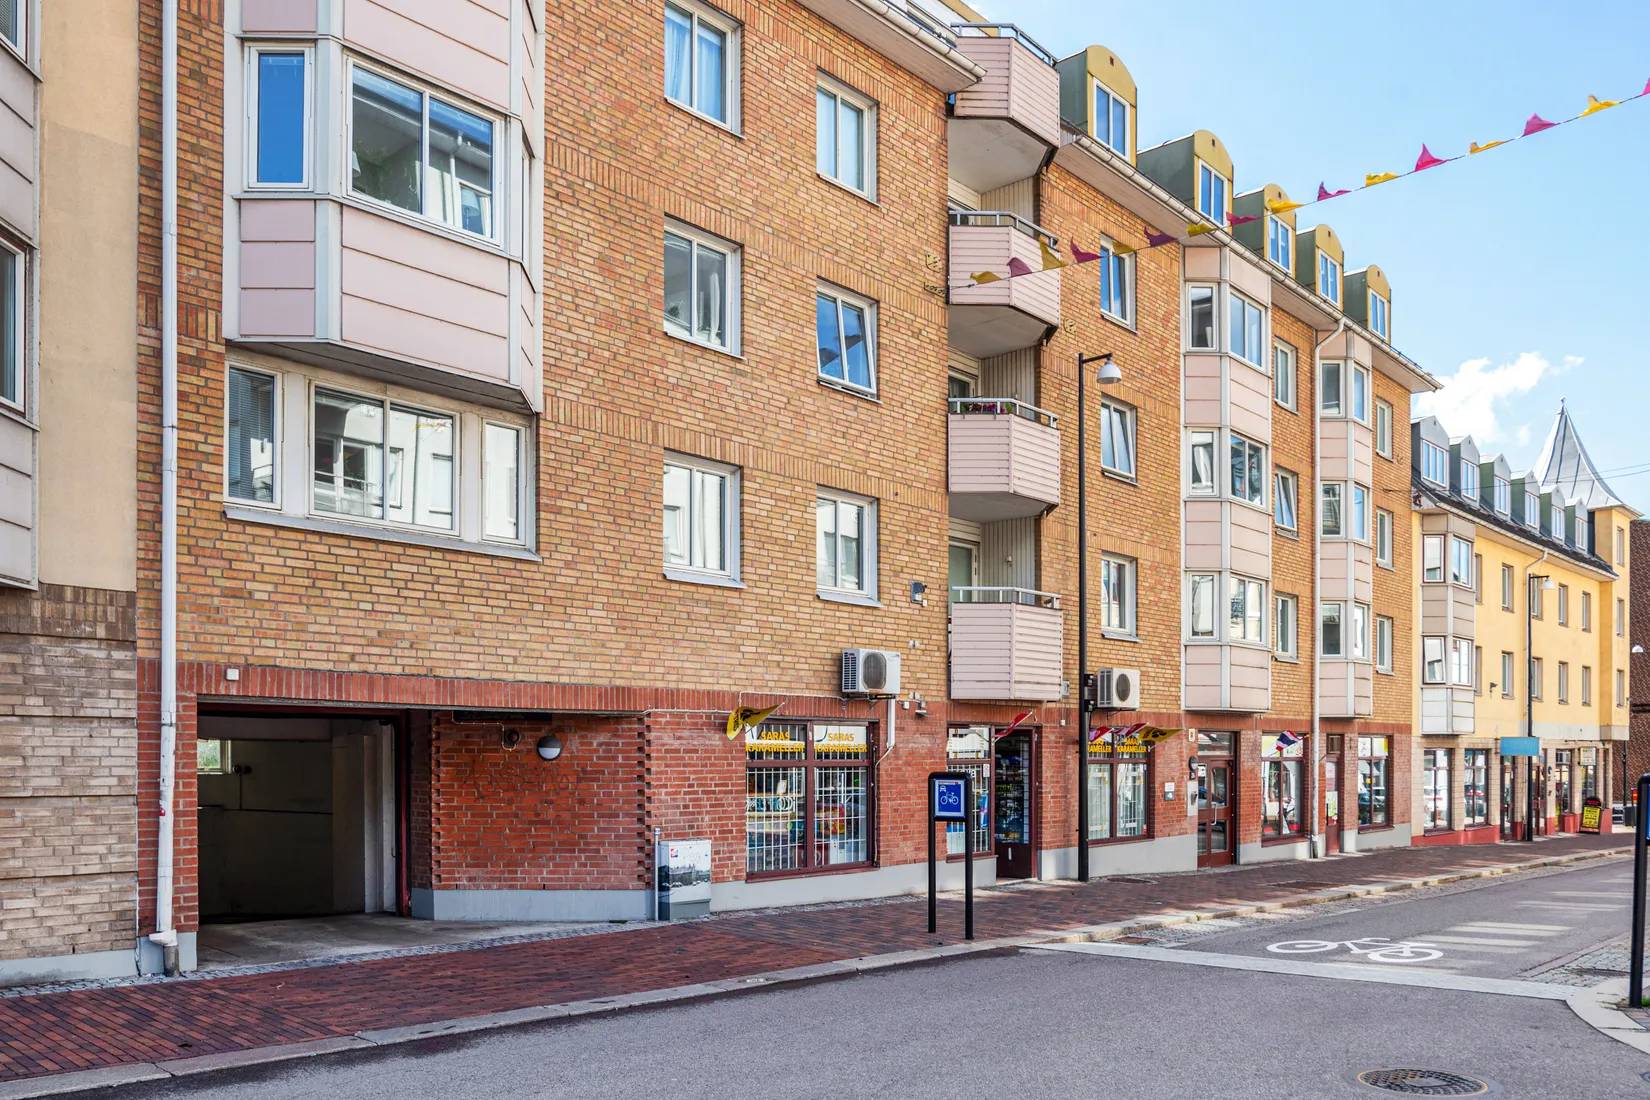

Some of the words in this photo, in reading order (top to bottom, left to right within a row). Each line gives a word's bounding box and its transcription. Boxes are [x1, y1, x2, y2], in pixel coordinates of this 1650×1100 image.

[760, 731, 790, 741] SARAS
[828, 733, 854, 742] SARAS
[745, 742, 804, 753] KARAMELLER
[815, 743, 867, 753] KARAMELLER
